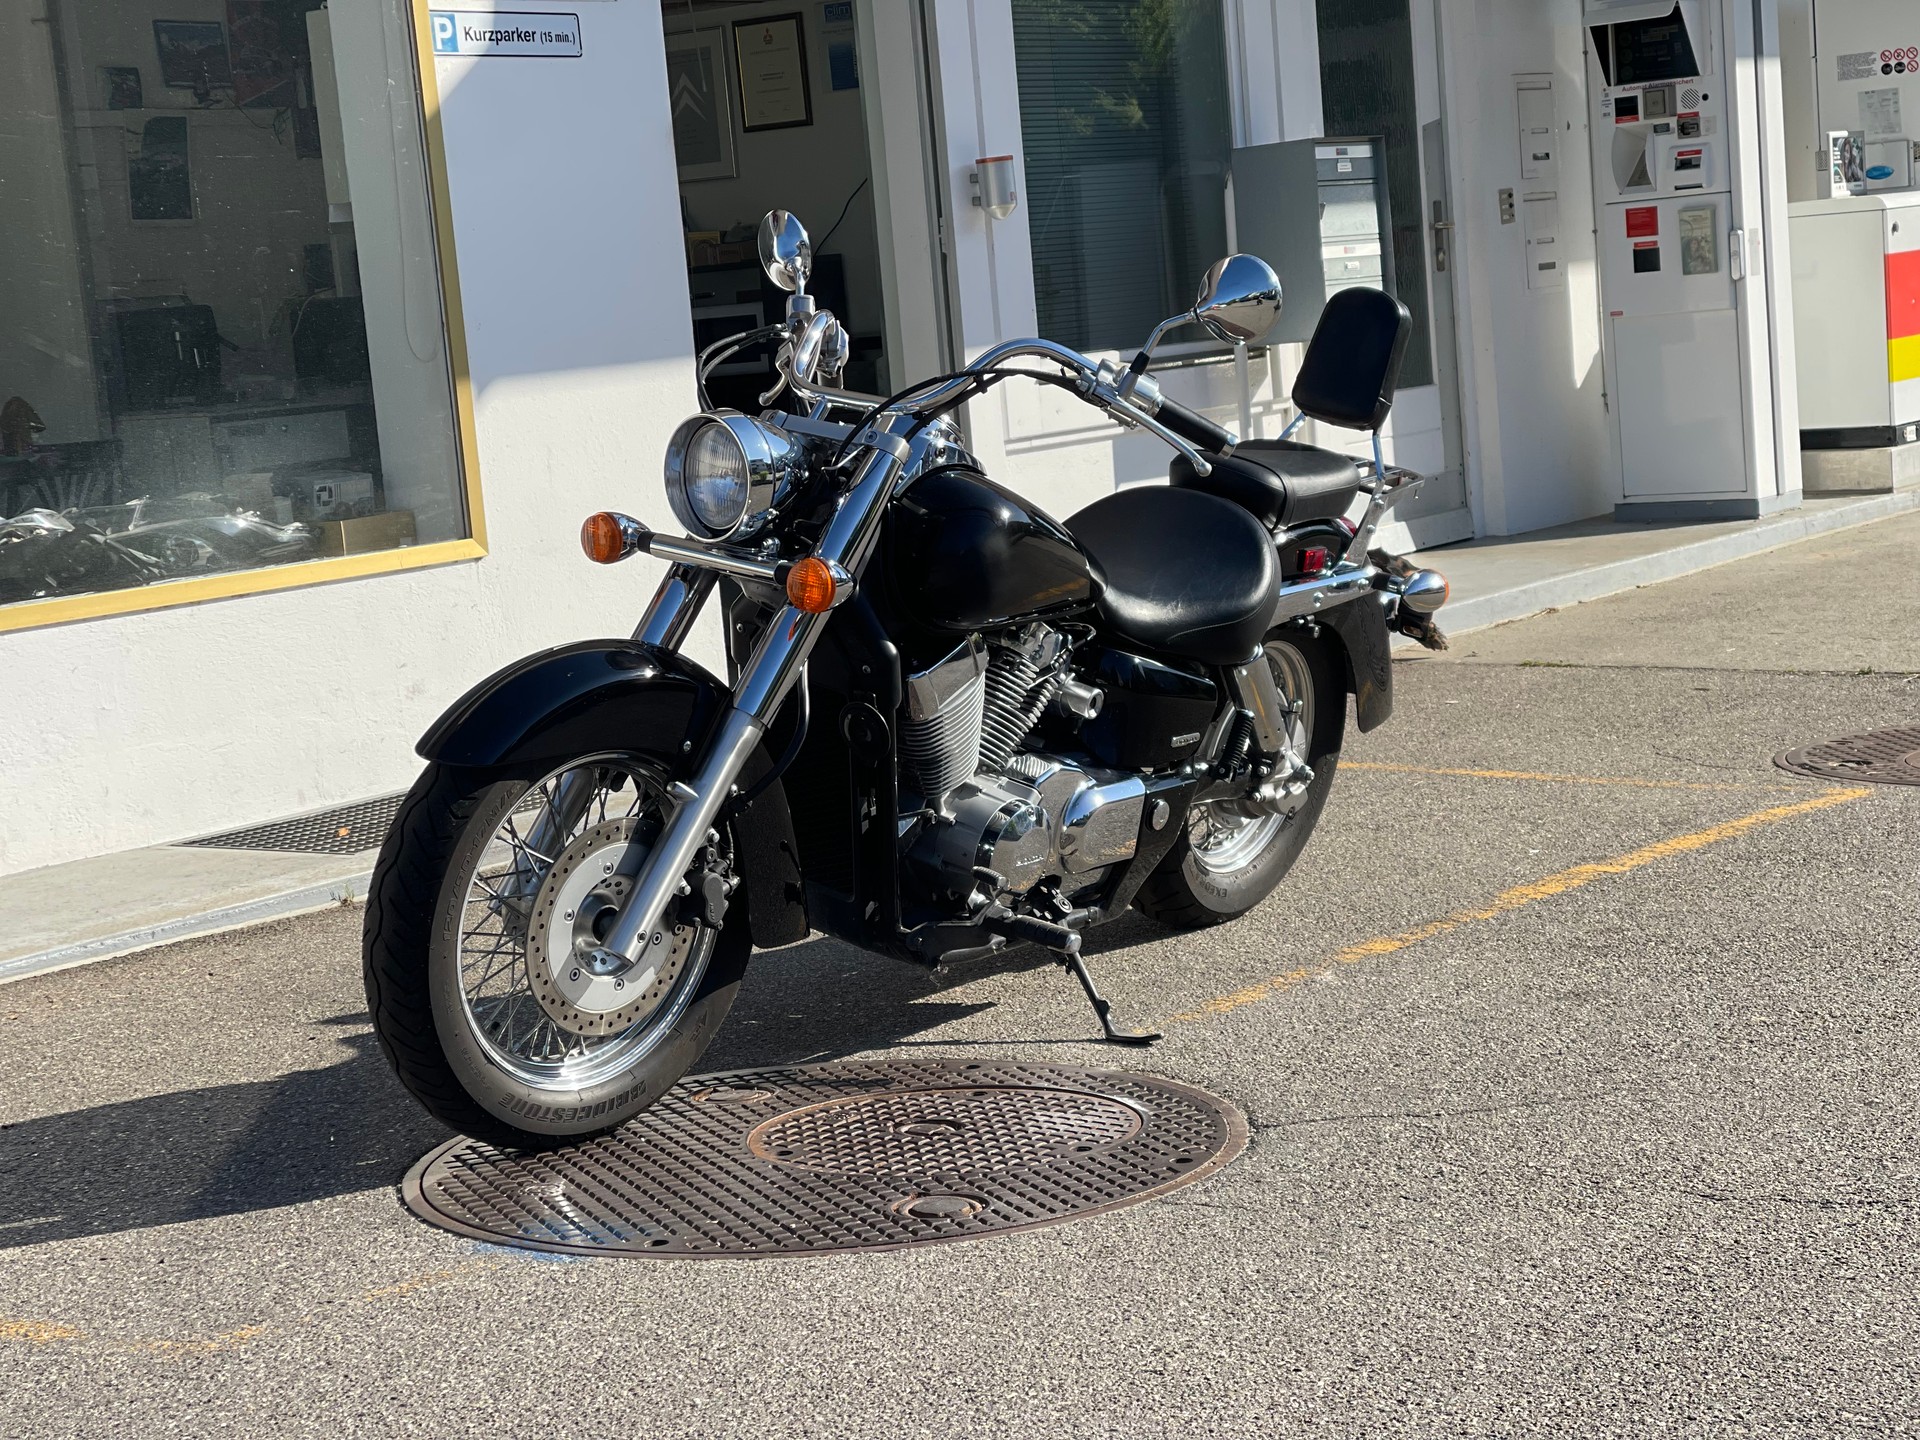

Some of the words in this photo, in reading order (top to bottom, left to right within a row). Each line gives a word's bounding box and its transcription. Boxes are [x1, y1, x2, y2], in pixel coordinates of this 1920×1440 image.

[433, 17, 453, 50] P
[463, 26, 536, 45] Kurzparker
[540, 31, 553, 45] (15
[555, 32, 576, 45] min.)
[499, 1080, 647, 1123] BRIDGESTONE
